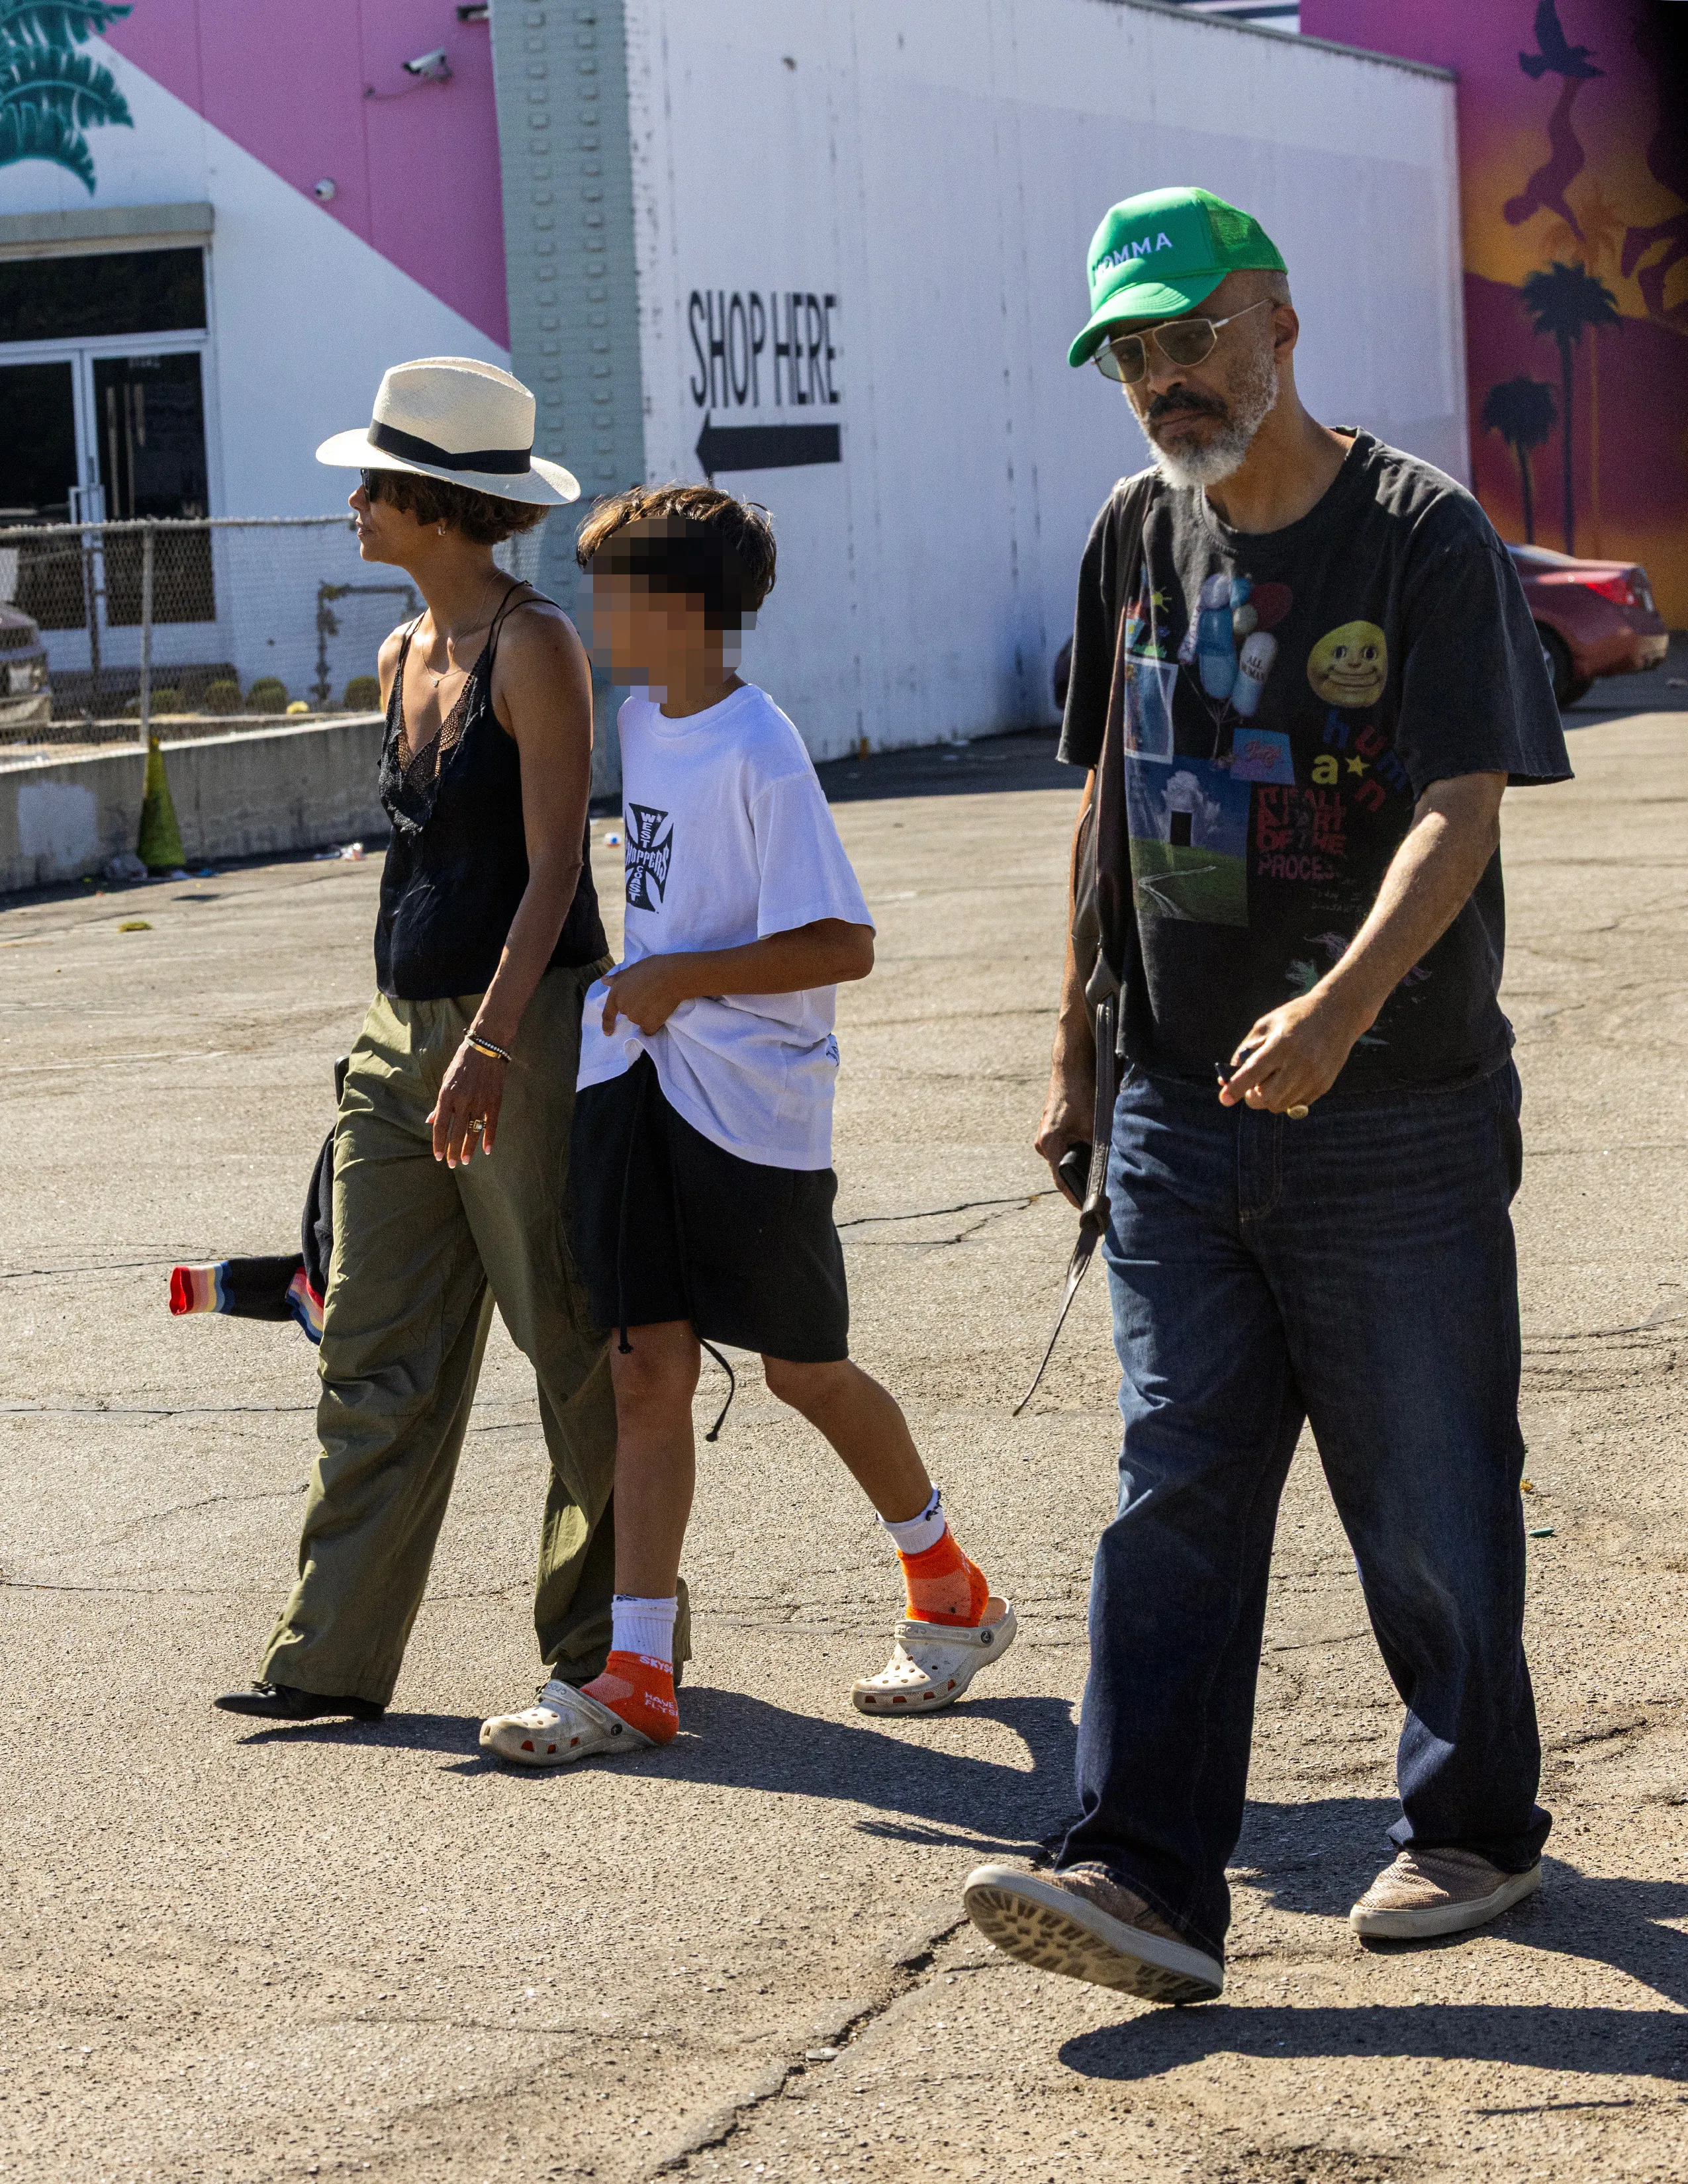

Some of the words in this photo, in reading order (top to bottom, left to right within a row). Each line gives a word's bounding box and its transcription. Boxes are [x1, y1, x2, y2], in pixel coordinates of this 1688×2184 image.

[688, 289, 767, 408] SHOP
[771, 291, 839, 407] HERE
[640, 811, 657, 848] WEST
[629, 865, 644, 901] COAST
